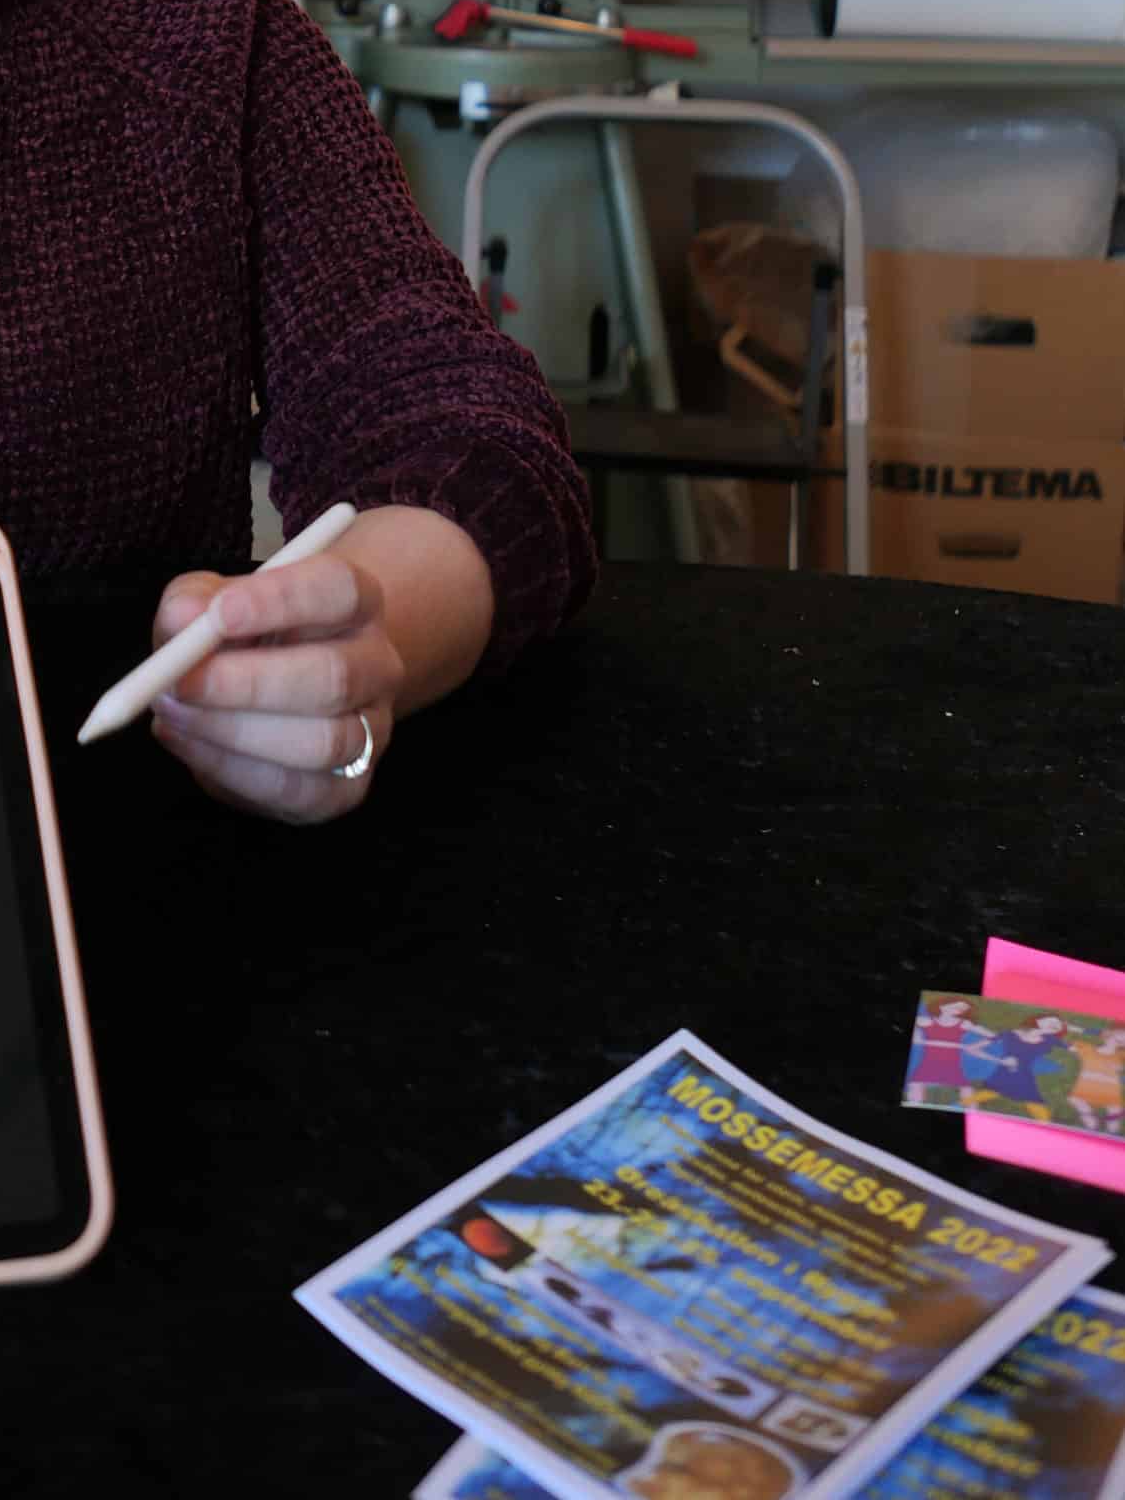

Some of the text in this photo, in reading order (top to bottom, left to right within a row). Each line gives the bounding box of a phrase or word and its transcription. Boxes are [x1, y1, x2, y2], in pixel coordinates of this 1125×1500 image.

[874, 462, 1103, 501] BILTEMA
[668, 1075, 927, 1232] MOSSEMESSA
[928, 1217, 1039, 1273] 2022
